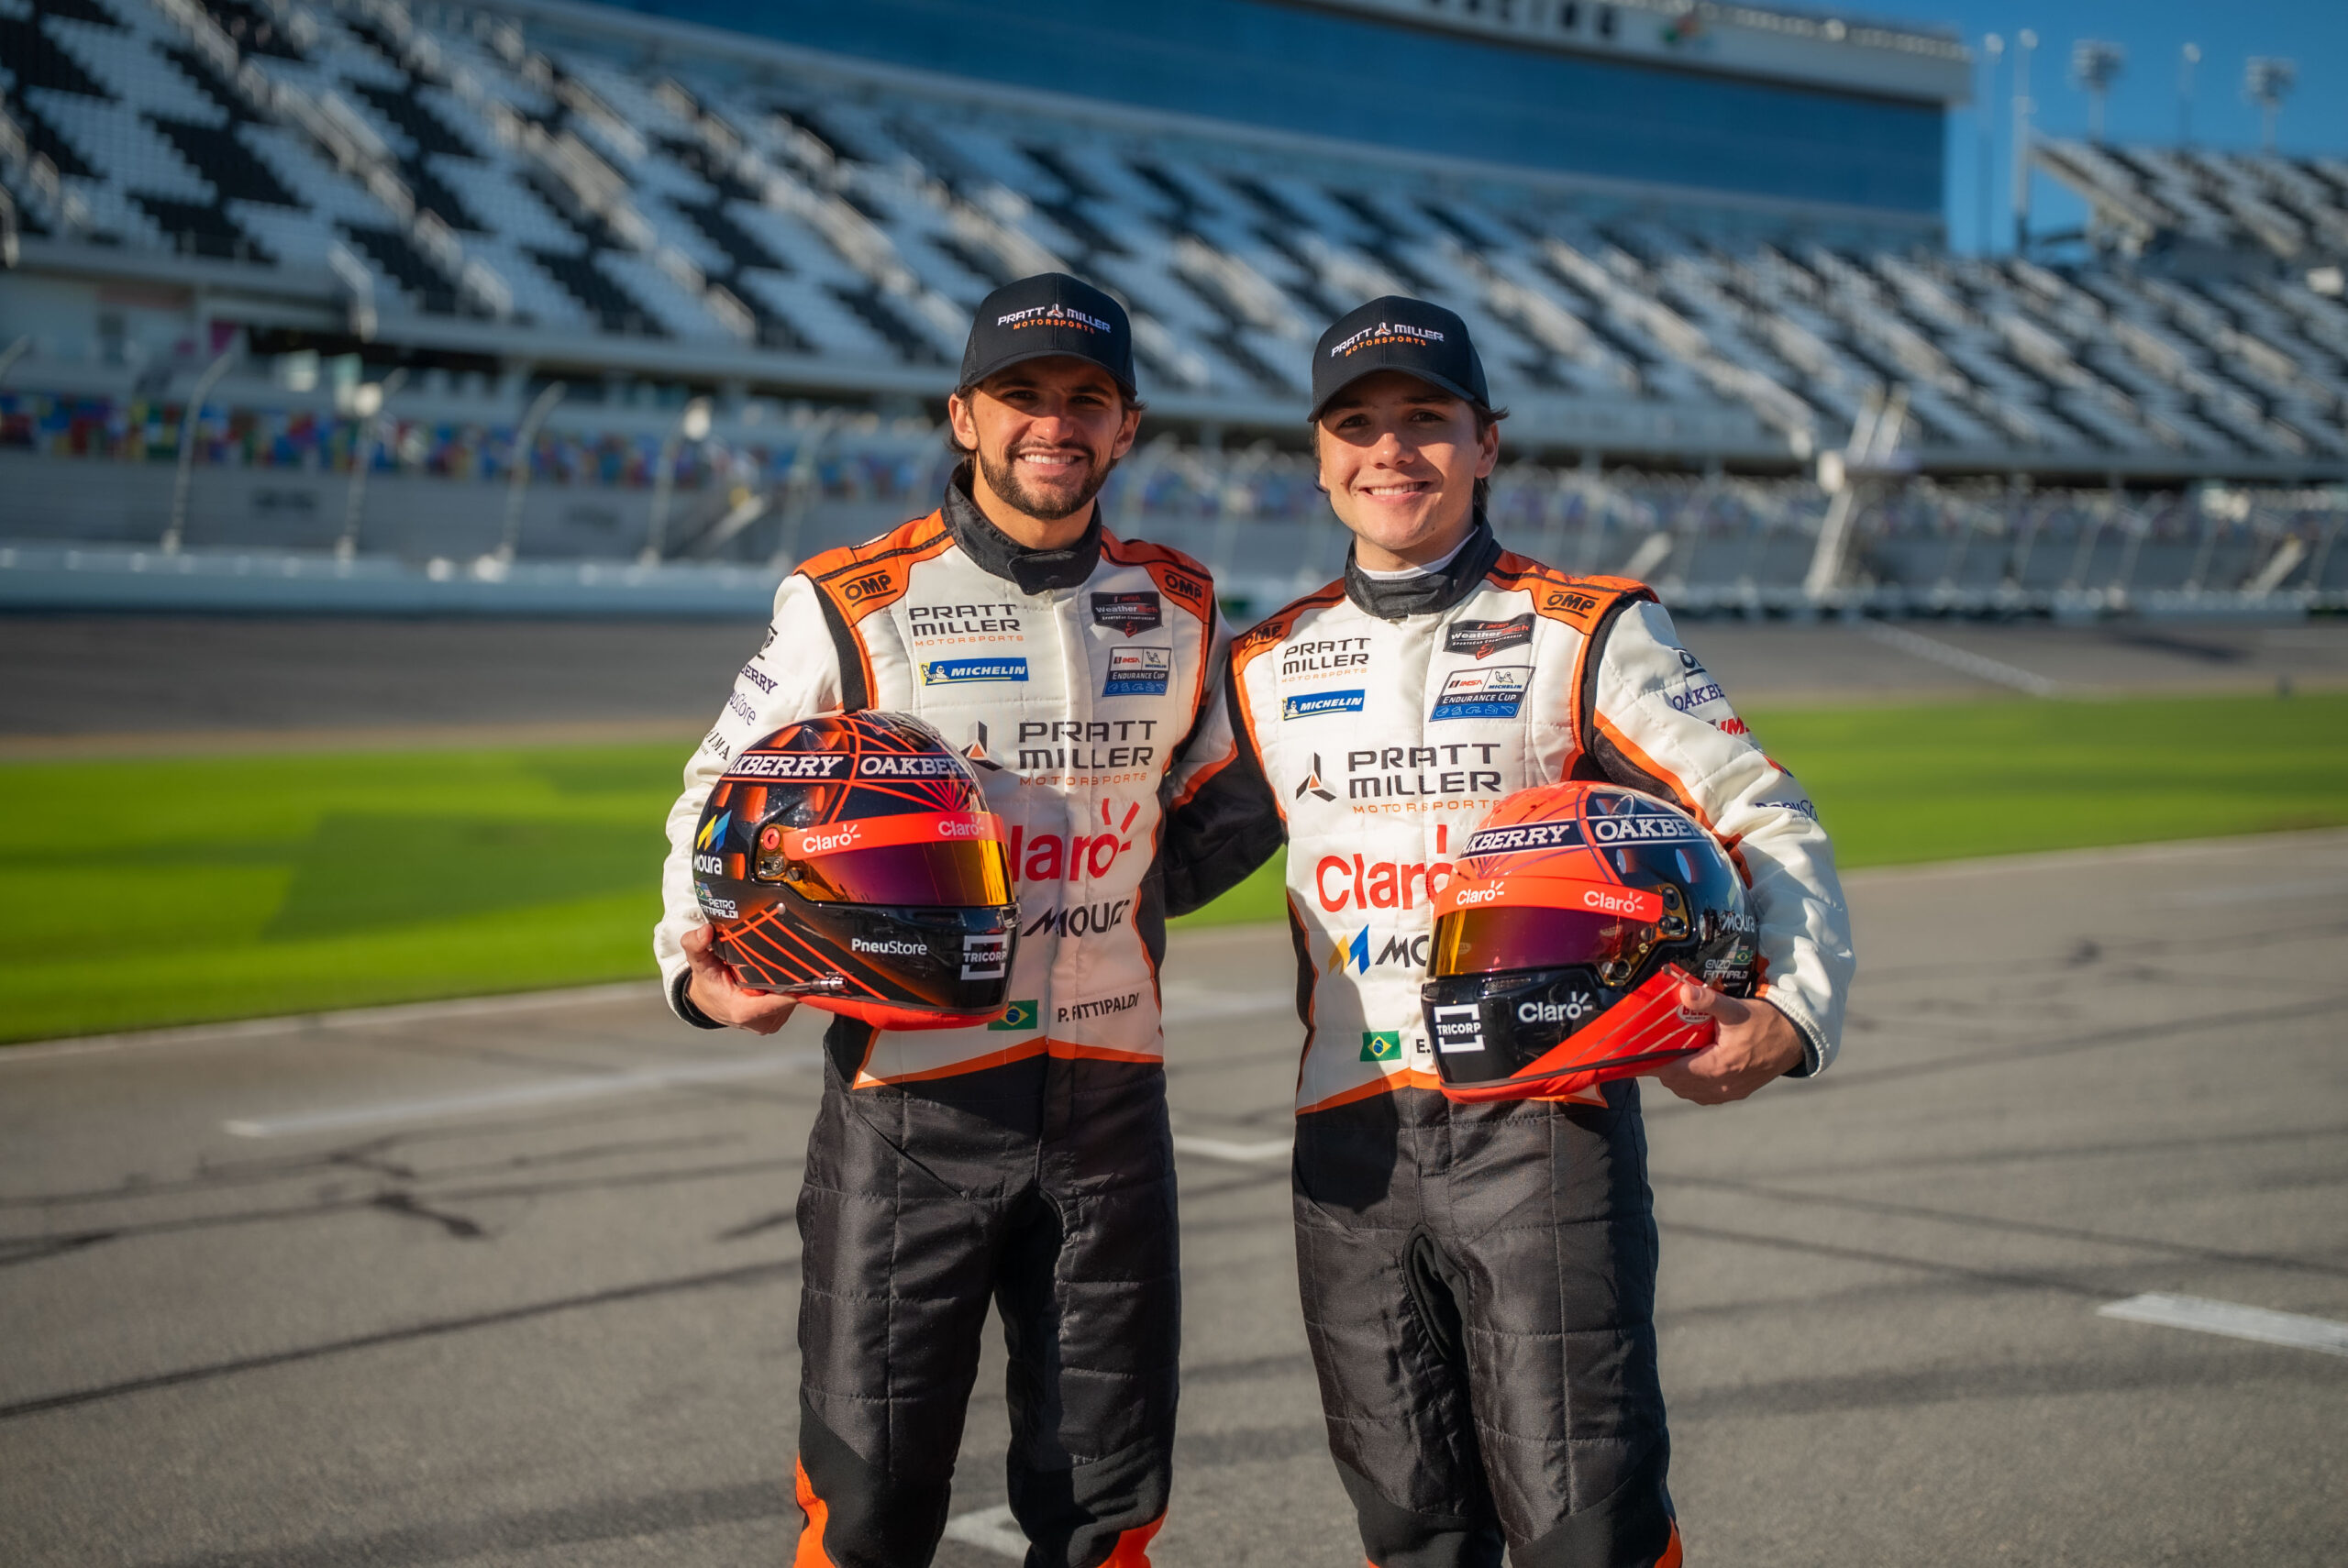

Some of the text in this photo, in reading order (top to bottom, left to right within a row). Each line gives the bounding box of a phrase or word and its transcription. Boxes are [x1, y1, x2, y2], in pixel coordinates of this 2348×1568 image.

[997, 306, 1112, 334] PRATT MILLER
[1013, 317, 1095, 335] MOTORSPORTS
[1331, 324, 1445, 358] PRATT MILLER
[1345, 336, 1426, 358] MOTORSPORTS
[844, 574, 892, 600] OMP
[1165, 575, 1202, 599] OMP
[1546, 593, 1595, 612] OMP
[909, 604, 1016, 620] PRATT
[912, 619, 1021, 636] MILLER
[914, 635, 1024, 646] MOTORSPORTS
[1283, 637, 1372, 659] PRATT
[950, 666, 1025, 677] MICHELIN
[1282, 653, 1369, 675] MILLER
[1113, 671, 1166, 680] ENDURANCE CUP
[1281, 668, 1368, 683] MOTORSPORTS
[1300, 697, 1362, 712] MICHELIN
[1443, 693, 1517, 704] ENDURANCE CUP
[1018, 720, 1157, 744] PRATT
[1018, 746, 1154, 769] MILLER
[1347, 743, 1501, 772] PRATT
[1019, 772, 1147, 786] MOTORSPORTS
[1348, 771, 1502, 799] MILLER
[938, 821, 979, 836] Claro
[803, 831, 851, 854] Claro
[708, 898, 736, 910] PIETRO
[1456, 887, 1495, 905] Claro
[1583, 890, 1634, 914] Claro
[851, 937, 927, 955] PneuStore
[963, 949, 1007, 963] TRICORP
[1705, 959, 1731, 969] ENZO
[1058, 992, 1139, 1023] P. FITTIPALDI
[1518, 1001, 1582, 1022] Claro
[1436, 1021, 1481, 1035] TRICORP
[1416, 1038, 1431, 1054] E.
